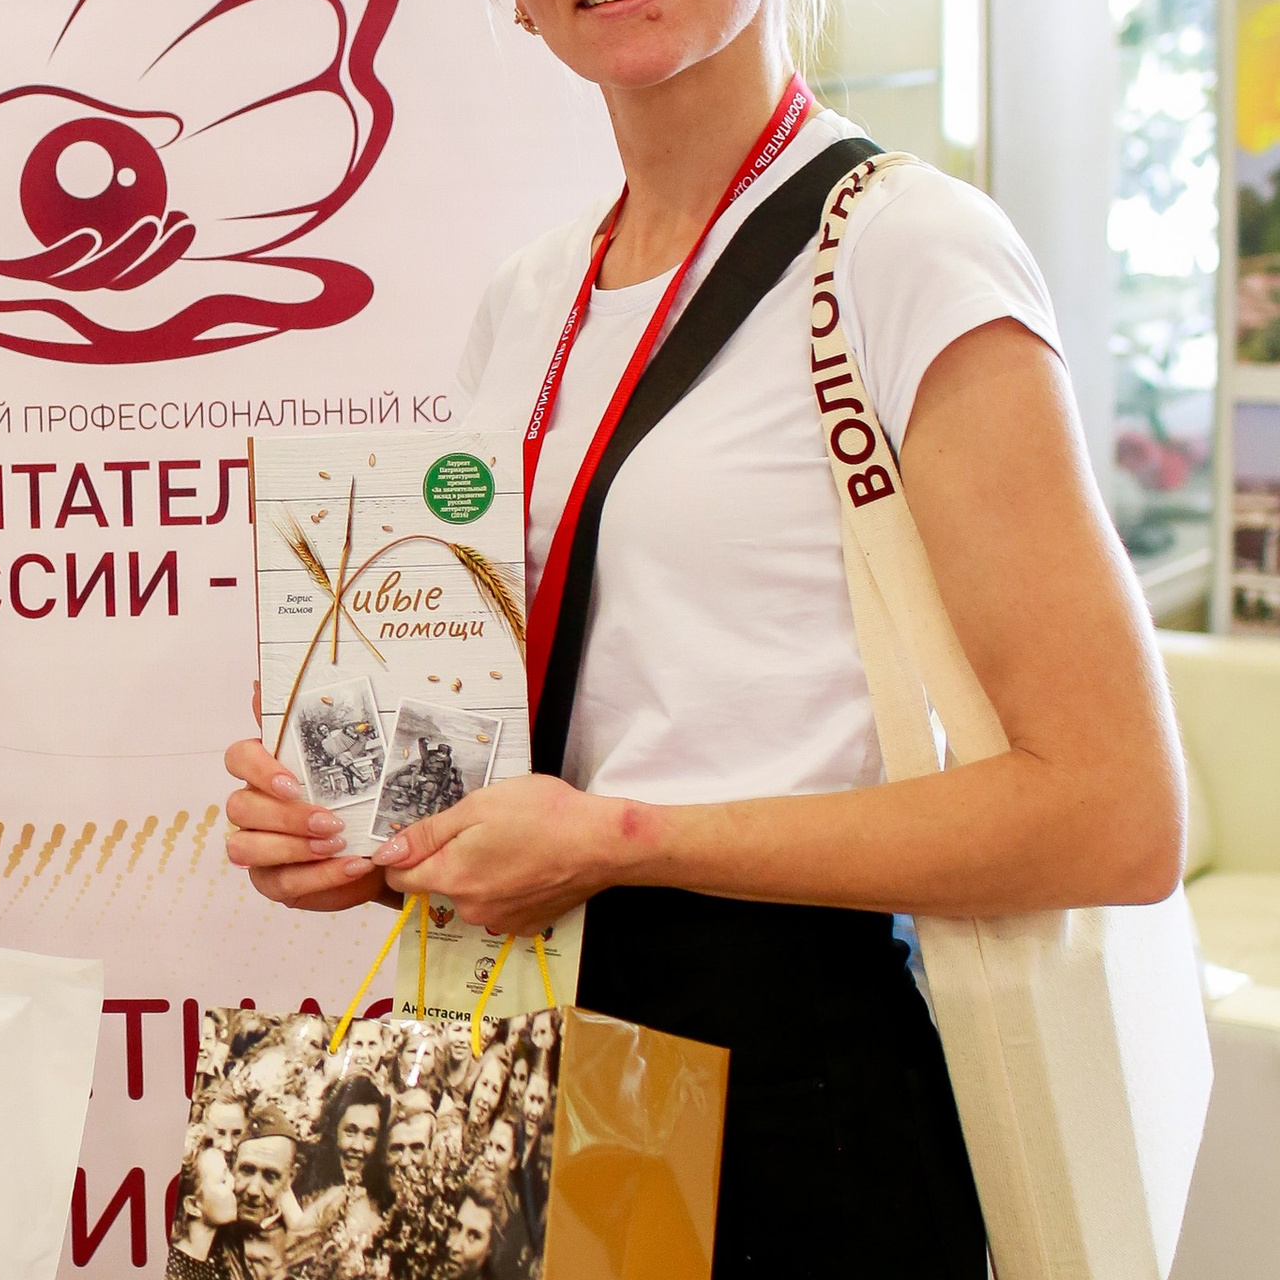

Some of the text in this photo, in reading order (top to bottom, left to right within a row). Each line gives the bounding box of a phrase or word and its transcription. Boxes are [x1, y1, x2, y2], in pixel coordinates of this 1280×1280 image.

[755, 92, 807, 169] ВОСПИТАТЕЛЬ
[527, 305, 580, 440] ВОСПИТАТЕЛЬ ГОДА
[24, 390, 400, 434] ПРОФЕССИОНАЛЬНЫЙ
[278, 606, 313, 615] Екимов
[286, 594, 313, 605] Борис
[380, 620, 486, 641] помощи
